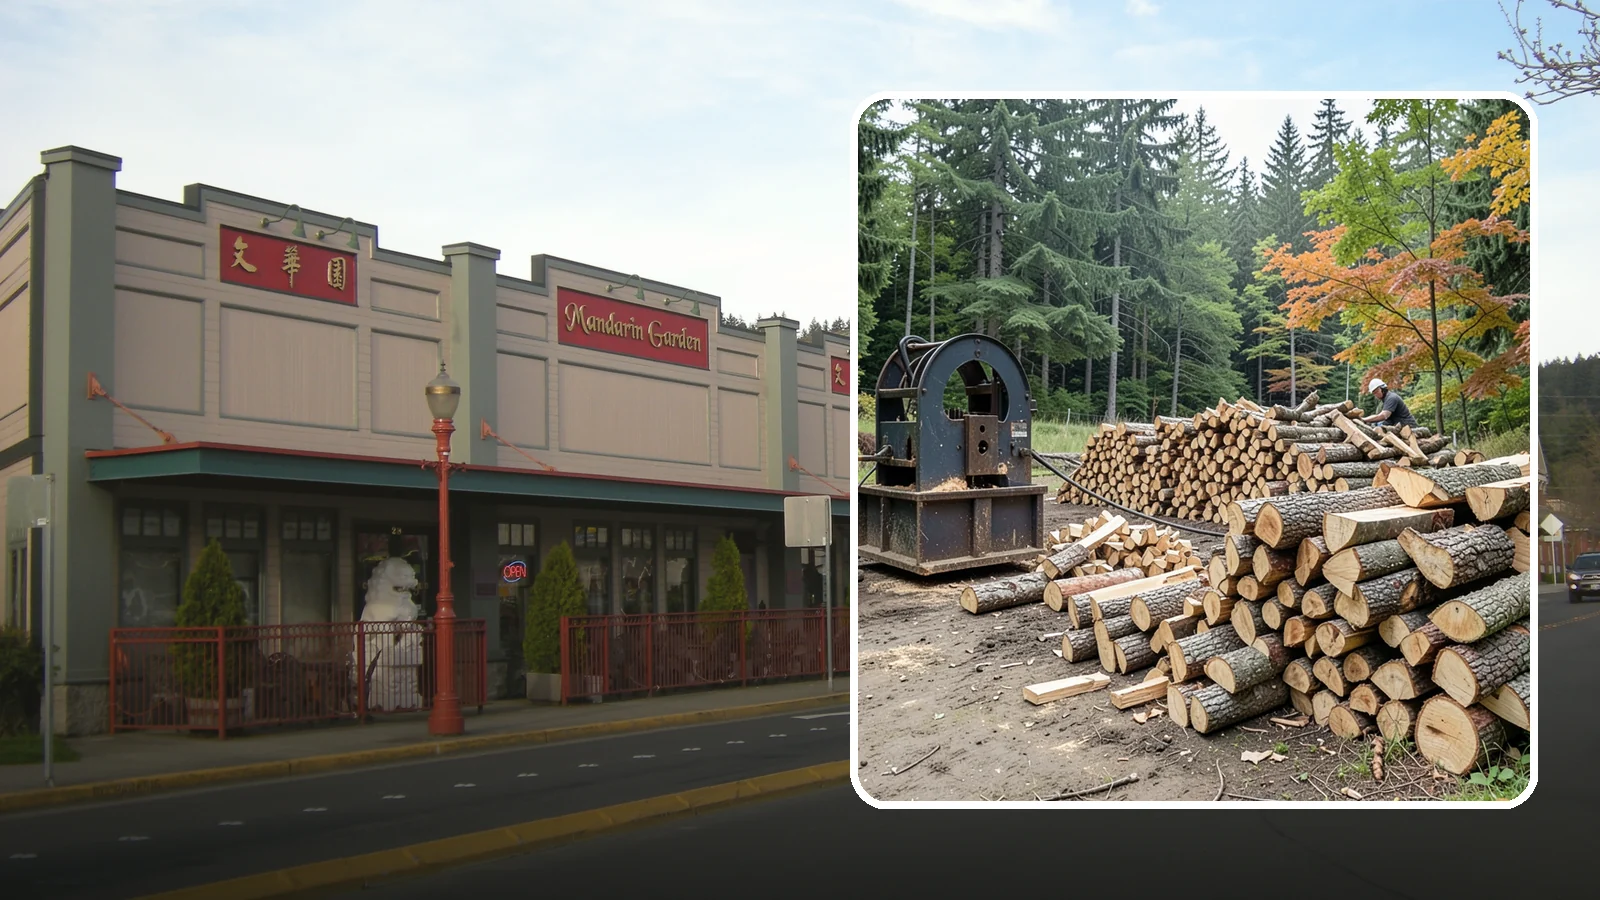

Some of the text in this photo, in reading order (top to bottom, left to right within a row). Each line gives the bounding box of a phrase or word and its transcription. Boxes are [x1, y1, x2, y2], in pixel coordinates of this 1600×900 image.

[230, 235, 347, 291] 文華園
[564, 302, 702, 352] Mandarin Garden
[503, 565, 527, 578] OPEN
